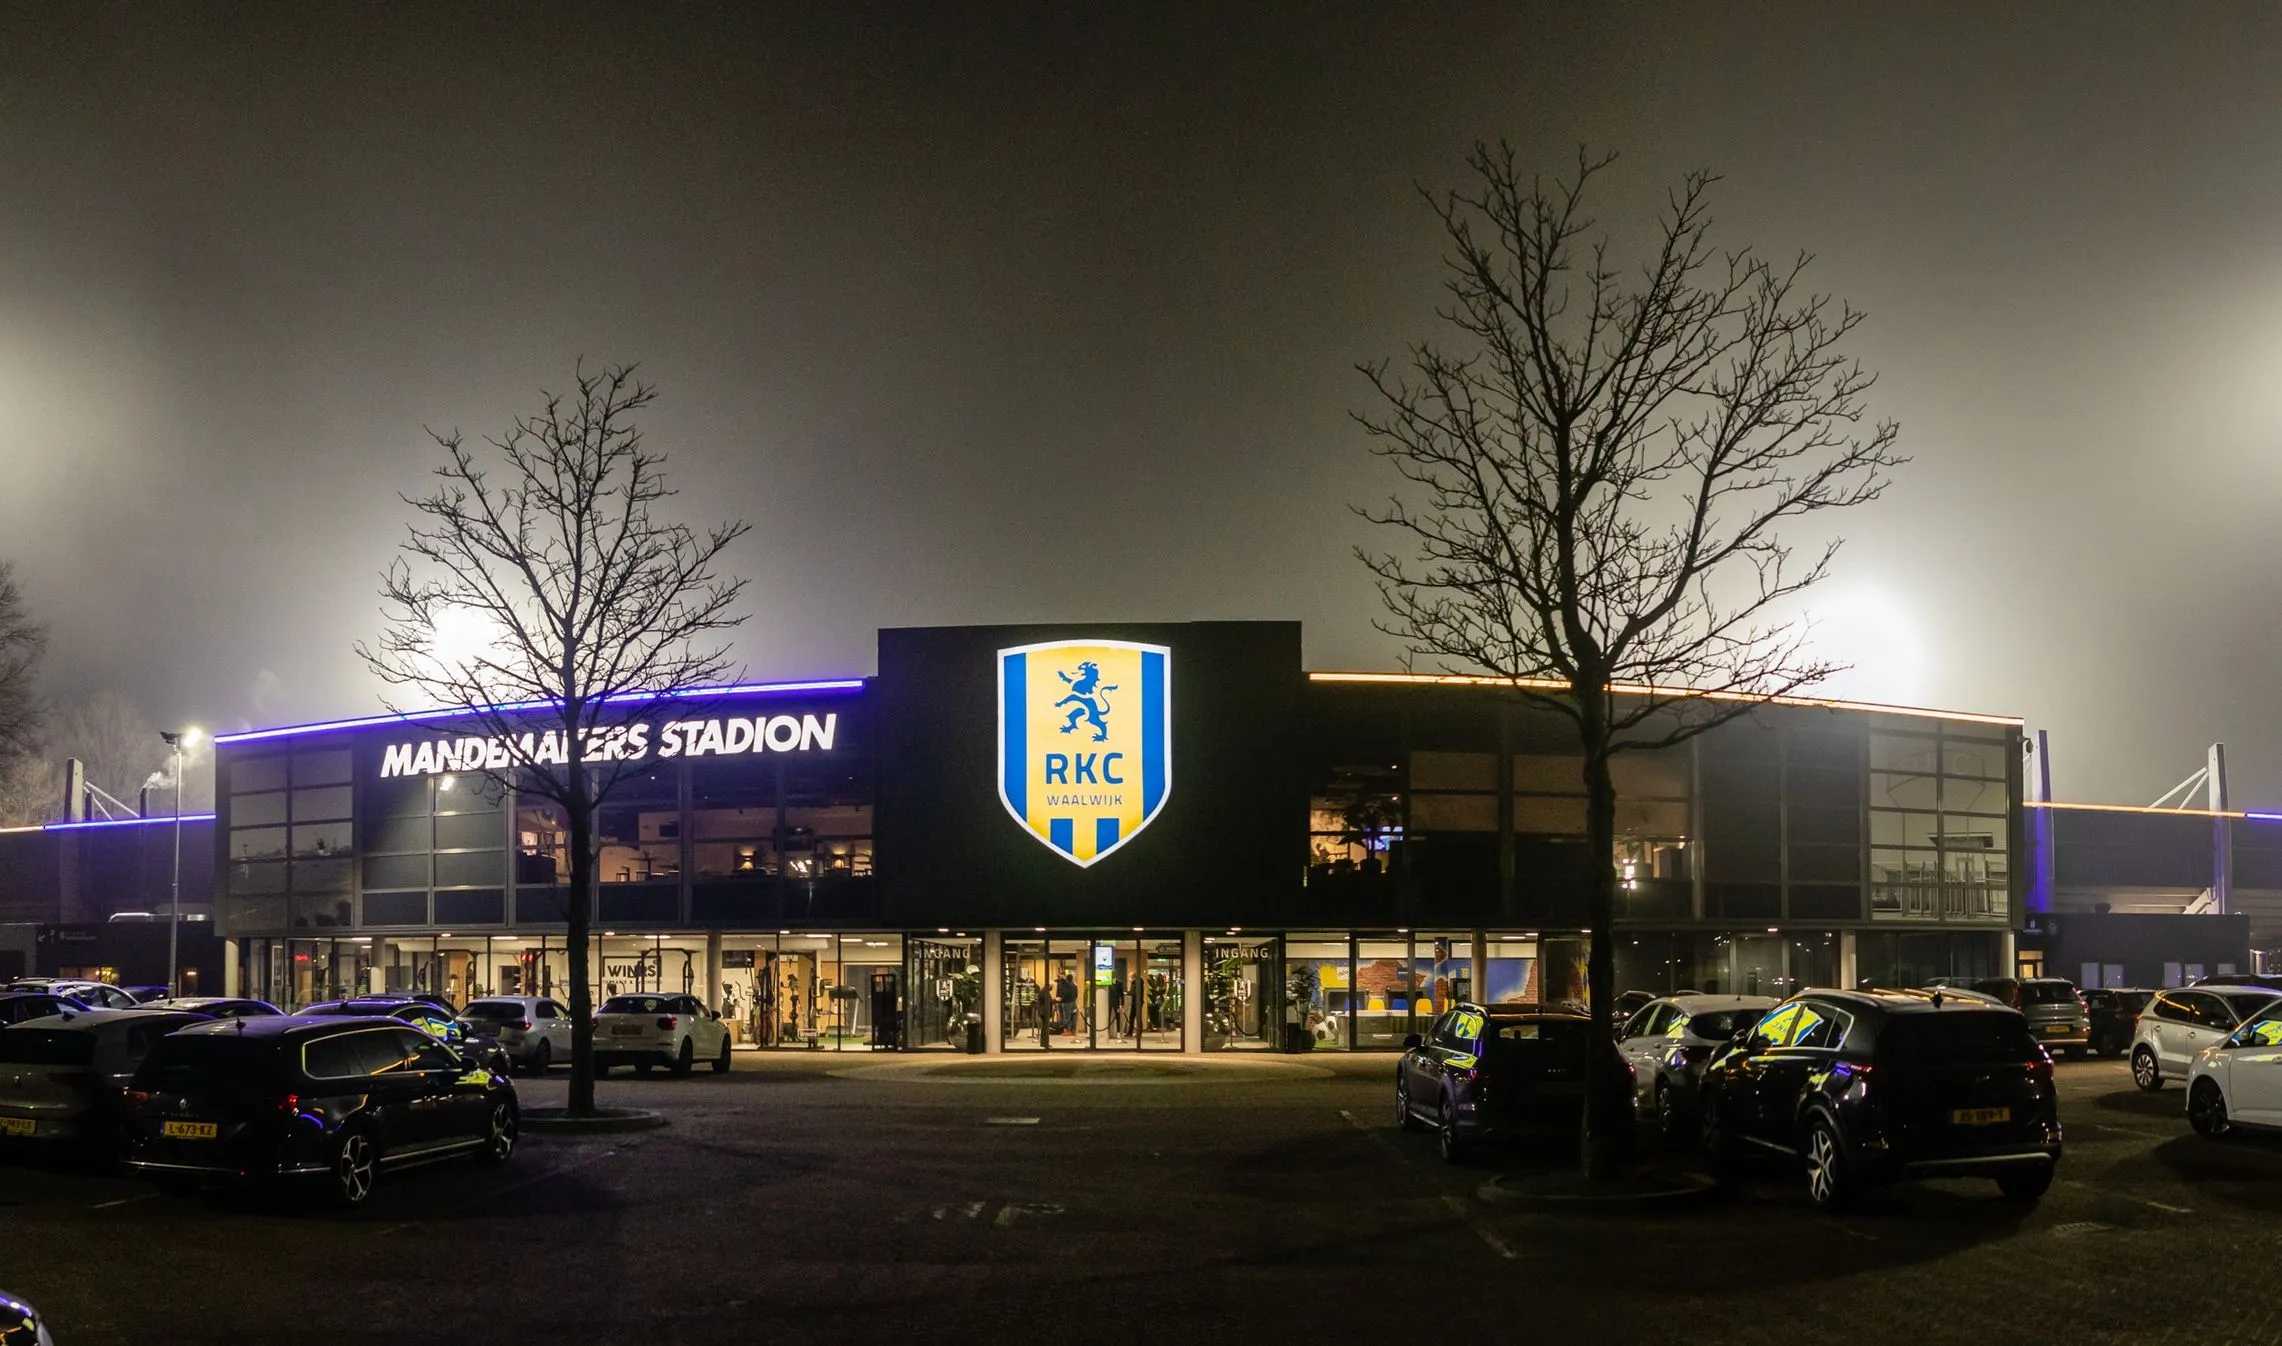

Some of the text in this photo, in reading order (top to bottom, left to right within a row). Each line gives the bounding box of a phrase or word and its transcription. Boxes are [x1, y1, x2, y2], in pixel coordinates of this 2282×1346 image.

[657, 713, 837, 758] STADION
[1046, 752, 1124, 784] RKC
[1047, 794, 1123, 806] WAALWIJK
[918, 948, 970, 959] INGANG
[1215, 947, 1269, 959] INGANG
